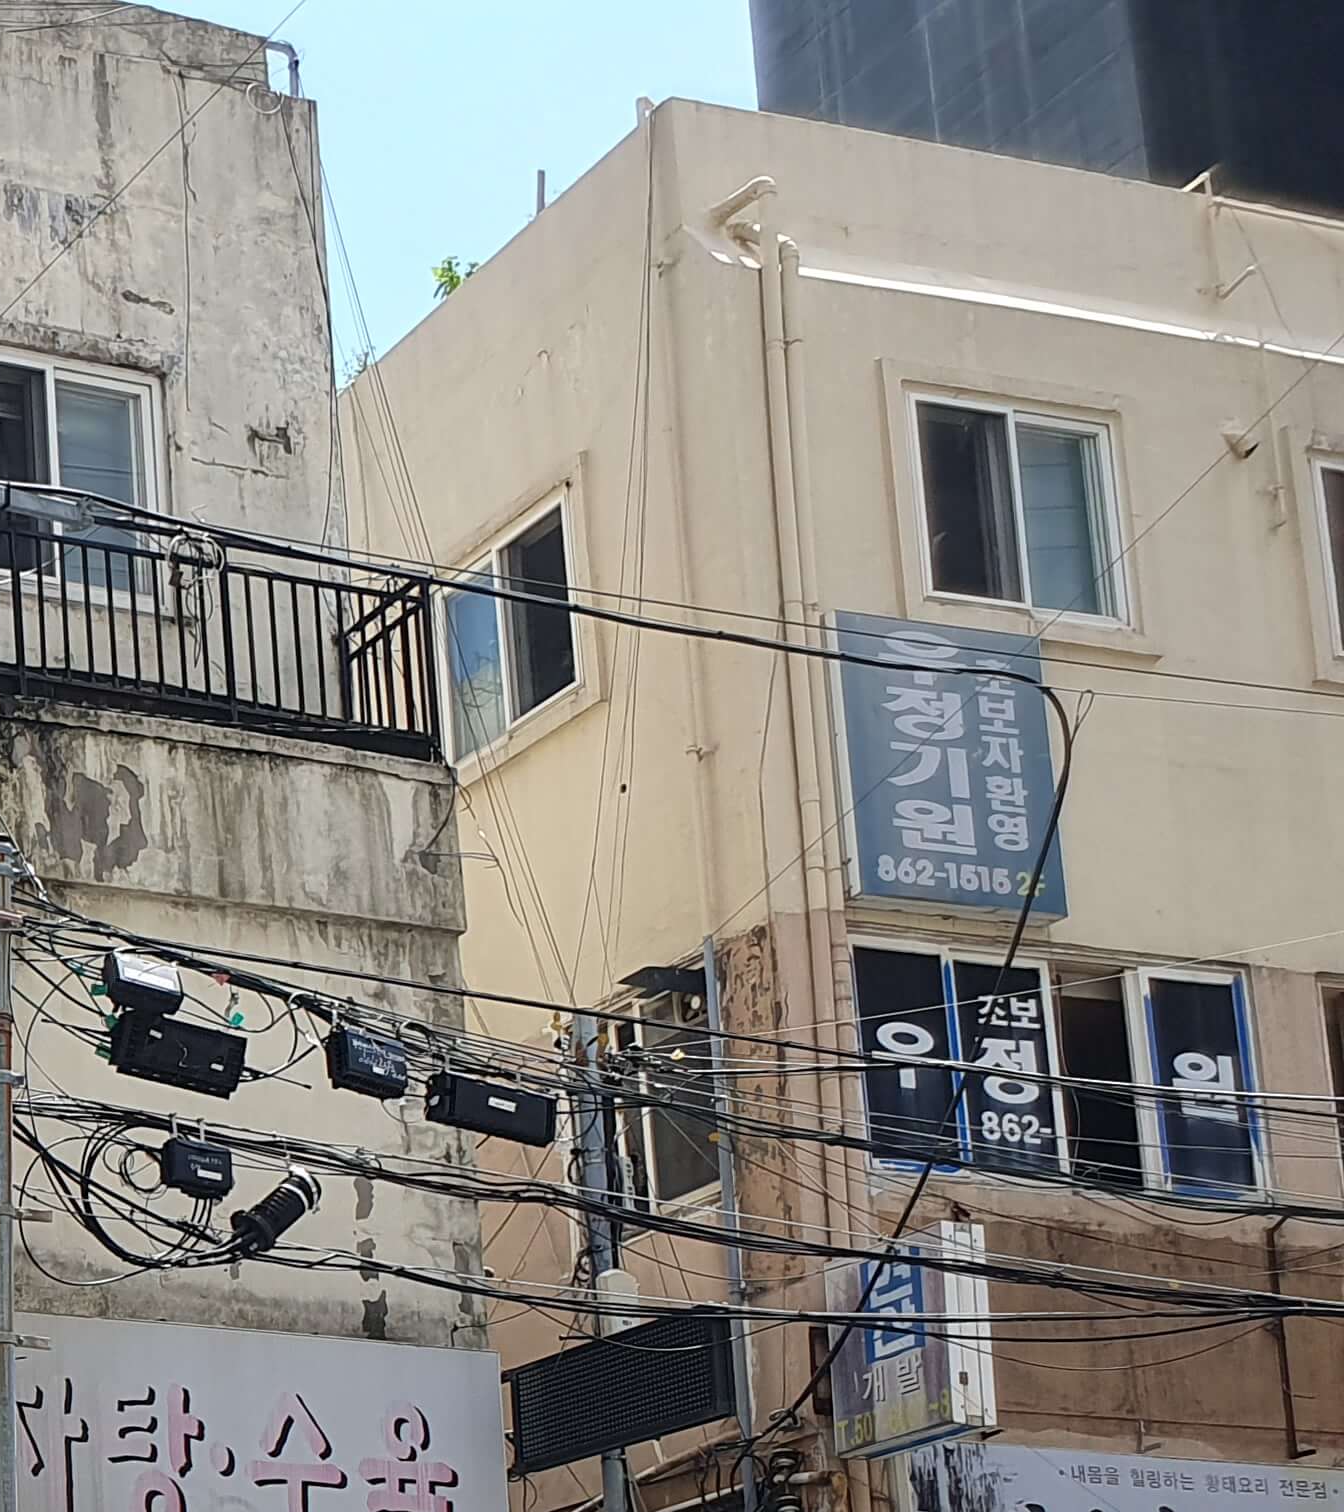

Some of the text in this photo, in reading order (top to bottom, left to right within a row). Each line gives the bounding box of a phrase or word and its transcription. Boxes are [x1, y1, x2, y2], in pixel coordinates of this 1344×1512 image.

[878, 630, 977, 855] 우정기원
[975, 658, 1030, 852] 초보자환영
[872, 1021, 935, 1090] 우
[974, 1037, 1040, 1104] 정
[982, 1110, 1053, 1145] 862-
[1130, 1468, 1196, 1491] 힐링하는
[1205, 1474, 1270, 1495] 황태요리
[1279, 1479, 1329, 1499] 전문점
